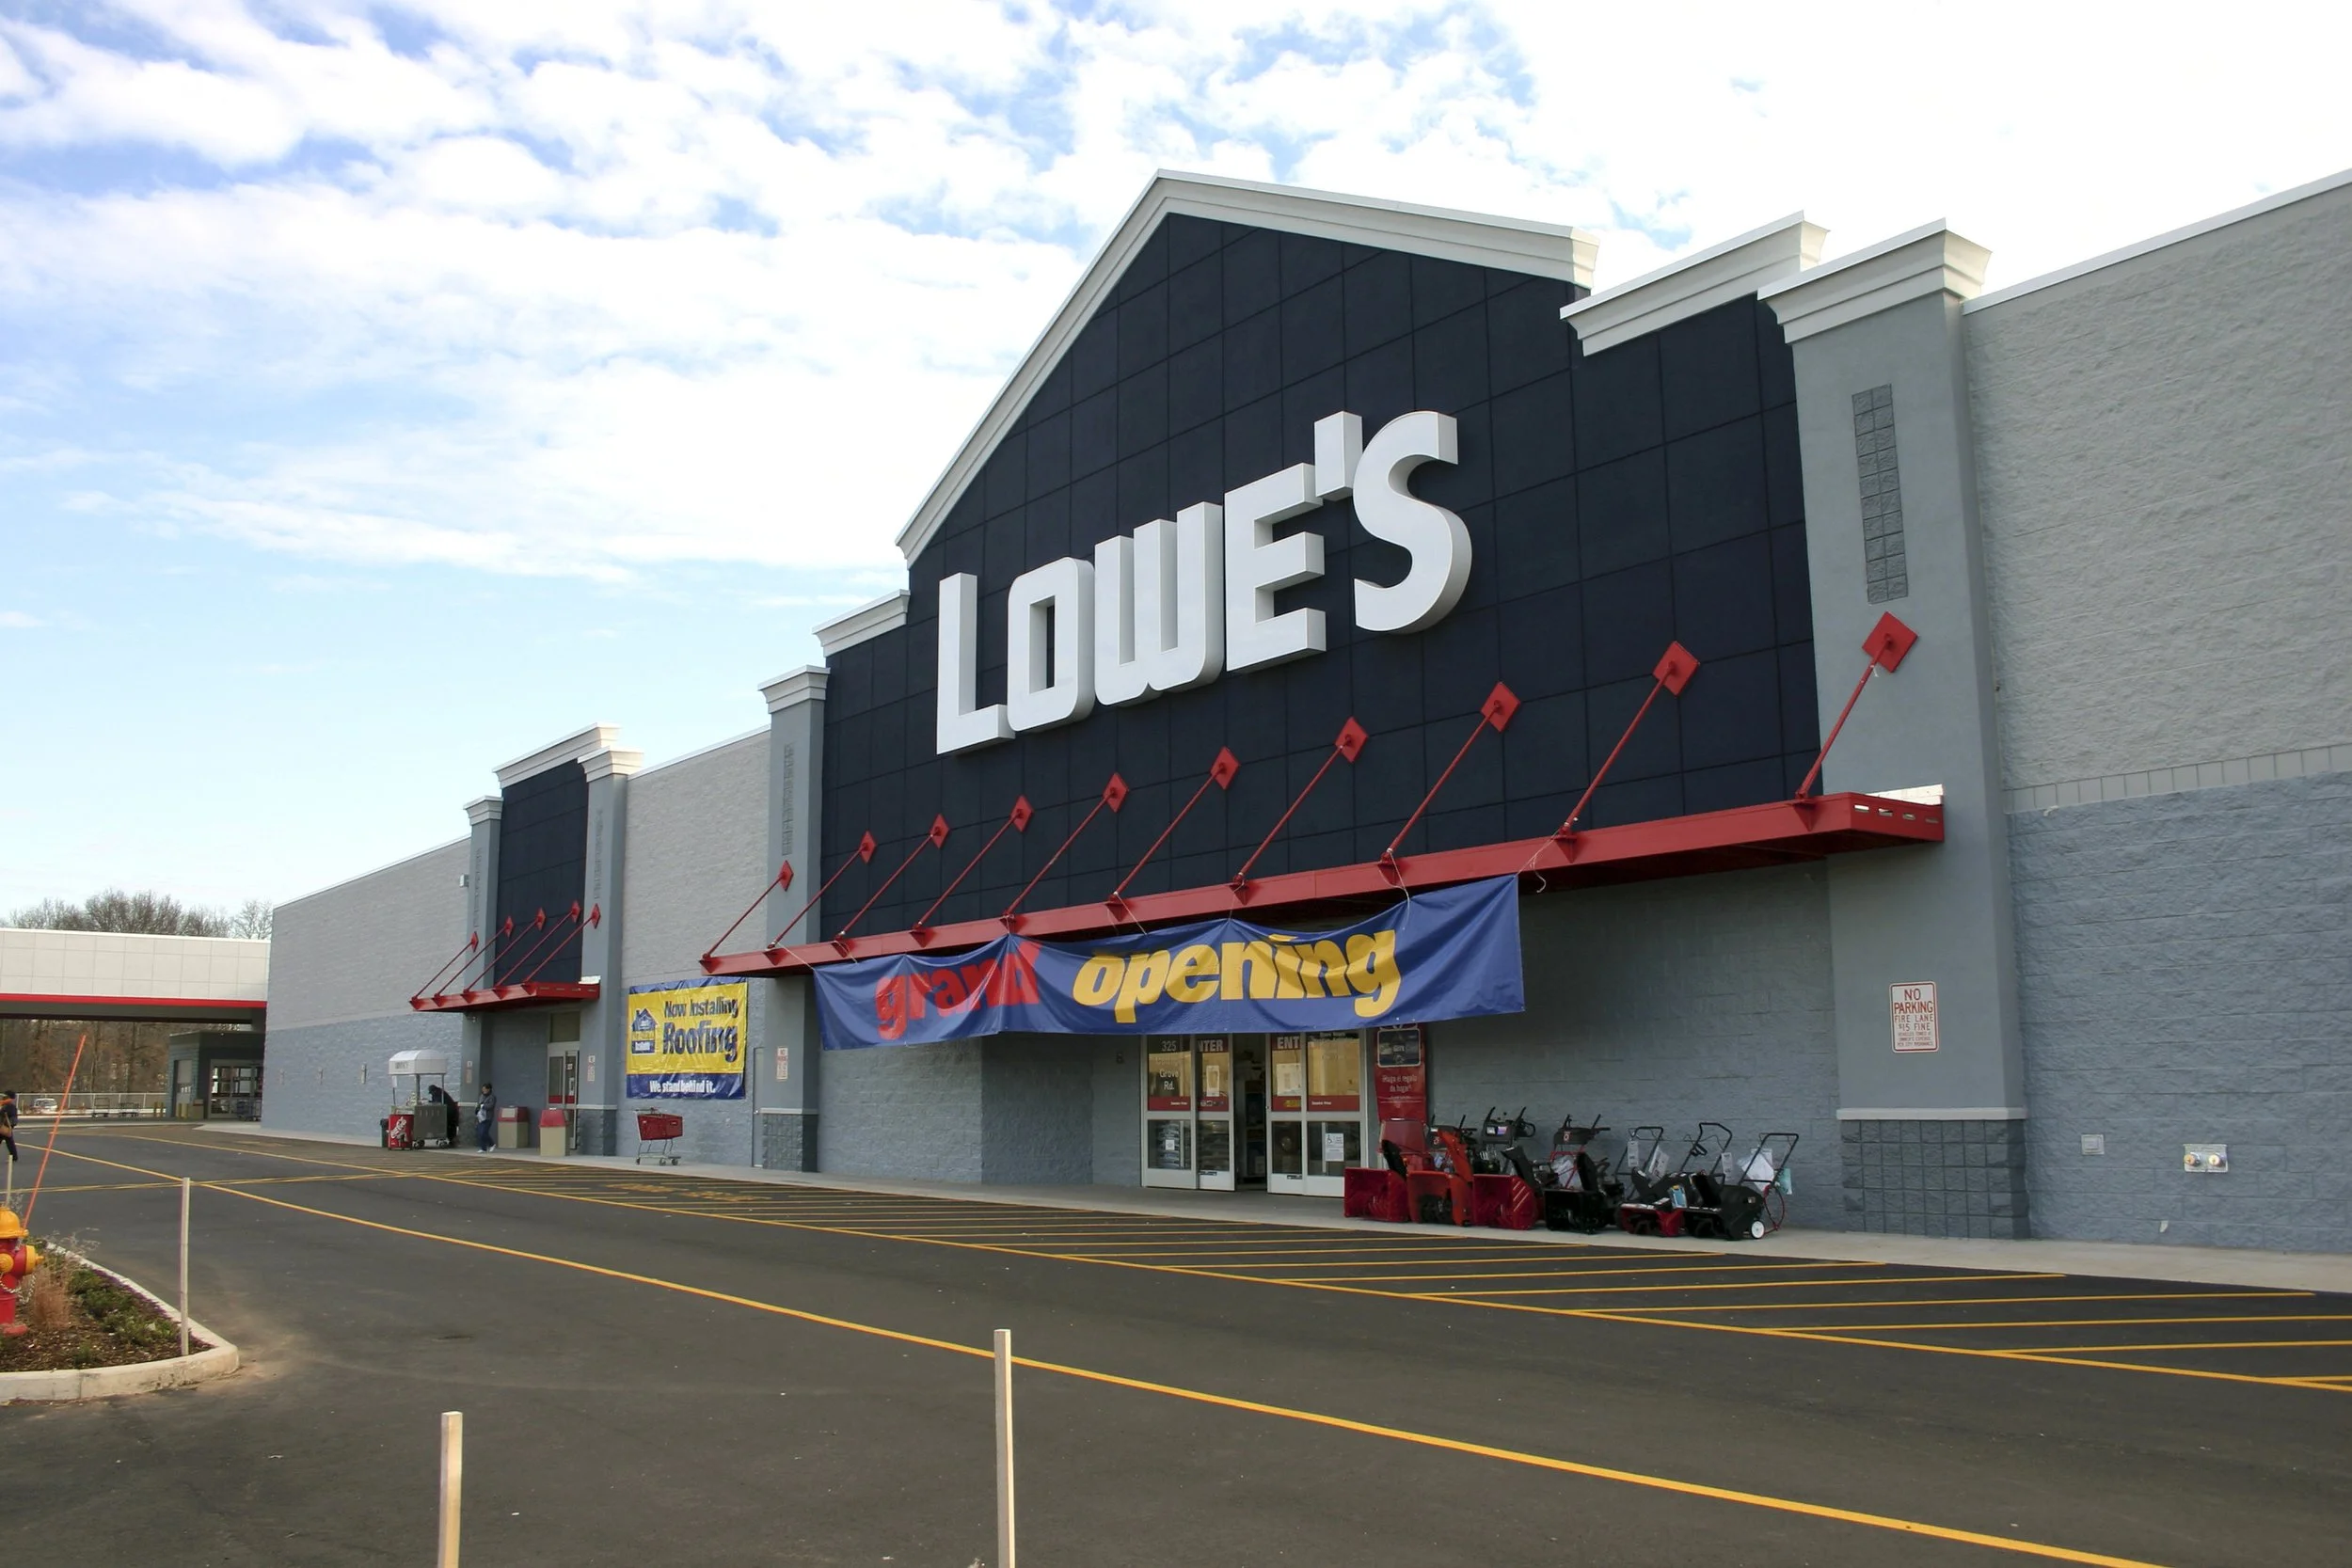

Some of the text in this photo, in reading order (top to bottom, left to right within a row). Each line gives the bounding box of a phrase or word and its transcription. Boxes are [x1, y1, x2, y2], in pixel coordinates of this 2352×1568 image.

[936, 410, 1472, 754] LOWE'S
[1073, 928, 1403, 1024] opening
[1904, 988, 1921, 1001] NO
[664, 997, 738, 1018] Now Installing
[1894, 1001, 1933, 1014] PARKING
[1894, 1013, 1933, 1023] FIRE LANE
[1914, 1022, 1931, 1031] FINE
[663, 1020, 738, 1062] Roofing
[1161, 1040, 1177, 1052] 325
[1198, 1039, 1223, 1052] NTER
[1277, 1036, 1300, 1049] ENT
[650, 1080, 716, 1093] We stand behind it.
[1164, 1081, 1174, 1090] Rd.
